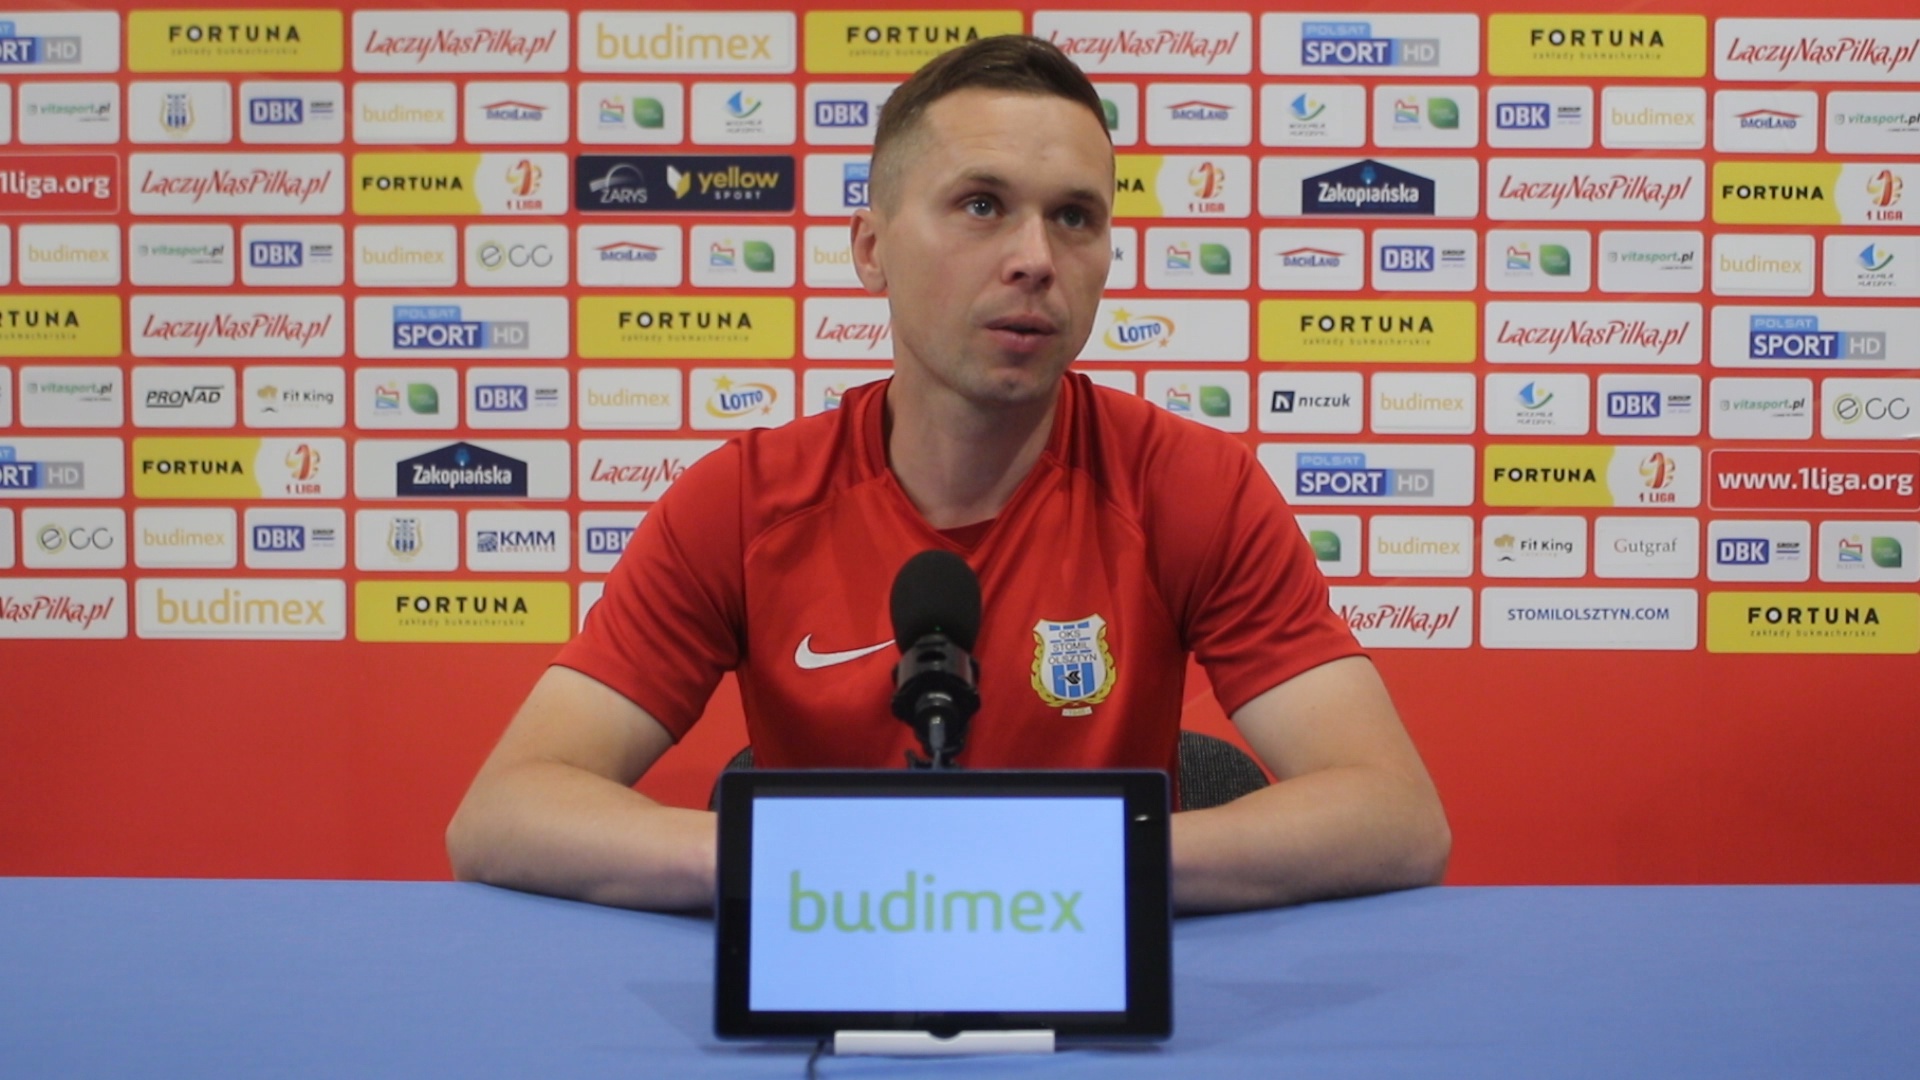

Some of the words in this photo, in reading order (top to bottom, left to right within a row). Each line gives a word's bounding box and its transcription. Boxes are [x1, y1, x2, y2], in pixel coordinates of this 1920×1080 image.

[169, 25, 300, 42] FORTUNA
[597, 23, 771, 60] budimex
[847, 26, 979, 43] FORTUNA
[1531, 29, 1664, 47] FORTUNA
[46, 41, 77, 60] HD
[1306, 40, 1388, 64] SPORT
[1403, 43, 1434, 63] HD
[253, 102, 298, 123] DBK
[363, 106, 444, 123] budimex
[818, 104, 863, 124] DBK
[1500, 106, 1545, 126] DBK
[1612, 108, 1694, 125] budimex
[362, 177, 463, 191] FORTUNA
[698, 165, 778, 195] yellow
[600, 188, 648, 203] ZARYS
[714, 191, 762, 200] SPORT
[1318, 182, 1419, 207] Zakopiańska
[1722, 185, 1824, 200] FORTUNA
[517, 201, 542, 209] LIGA
[1199, 204, 1225, 212] LIGA
[1876, 211, 1903, 220] LIGA
[28, 243, 110, 263] budimex
[253, 243, 299, 265] DBK
[362, 247, 444, 264] budimex
[1385, 249, 1431, 269] DBK
[1720, 254, 1801, 273] budimex
[0, 311, 79, 327] TUNA
[619, 312, 752, 329] FORTUNA
[1301, 316, 1433, 333] FORTUNA
[1754, 319, 1812, 328] POLSAT
[397, 324, 478, 347] SPORT
[493, 327, 524, 344] HD
[1118, 322, 1161, 343] LOTTO
[1753, 335, 1834, 356] SPORT
[1849, 338, 1880, 355] HD
[146, 387, 223, 406] PRONAD
[283, 390, 301, 403] Fit
[303, 390, 334, 406] King
[478, 387, 525, 408] DBK
[588, 389, 670, 406] budimex
[720, 391, 764, 411] LOTTO
[1381, 393, 1463, 411] budimex
[1611, 395, 1656, 415] DBK
[1732, 398, 1805, 412] vitasport.pl
[143, 460, 244, 474] FORTUNA
[1301, 456, 1360, 465] POLSAT
[48, 467, 79, 485] HD
[413, 463, 513, 488] Zakopiańska
[1301, 472, 1382, 494] SPORT
[1397, 474, 1428, 491] HD
[1494, 467, 1596, 482] FORTUNA
[1718, 468, 1914, 496] www.1liga.org
[296, 485, 321, 493] LIGA
[1649, 493, 1676, 502] LIGA
[143, 528, 225, 546] budimex
[256, 528, 301, 549] DBK
[500, 531, 555, 546] KMM
[1377, 537, 1460, 556] budimex
[1521, 539, 1537, 551] Fit
[1541, 539, 1573, 553] King
[1613, 538, 1677, 556] Gutgraf
[1720, 541, 1766, 562] DBK
[156, 589, 325, 625] budimex
[397, 597, 527, 614] FORTUNA
[1507, 607, 1670, 621] STOMILOLSZTYN.COM
[1748, 607, 1880, 624] FORTUNA
[1059, 629, 1081, 639] OKS
[1053, 642, 1089, 652] STOMIL
[1048, 653, 1098, 665] OLSZTYN
[789, 870, 1085, 933] budimex
